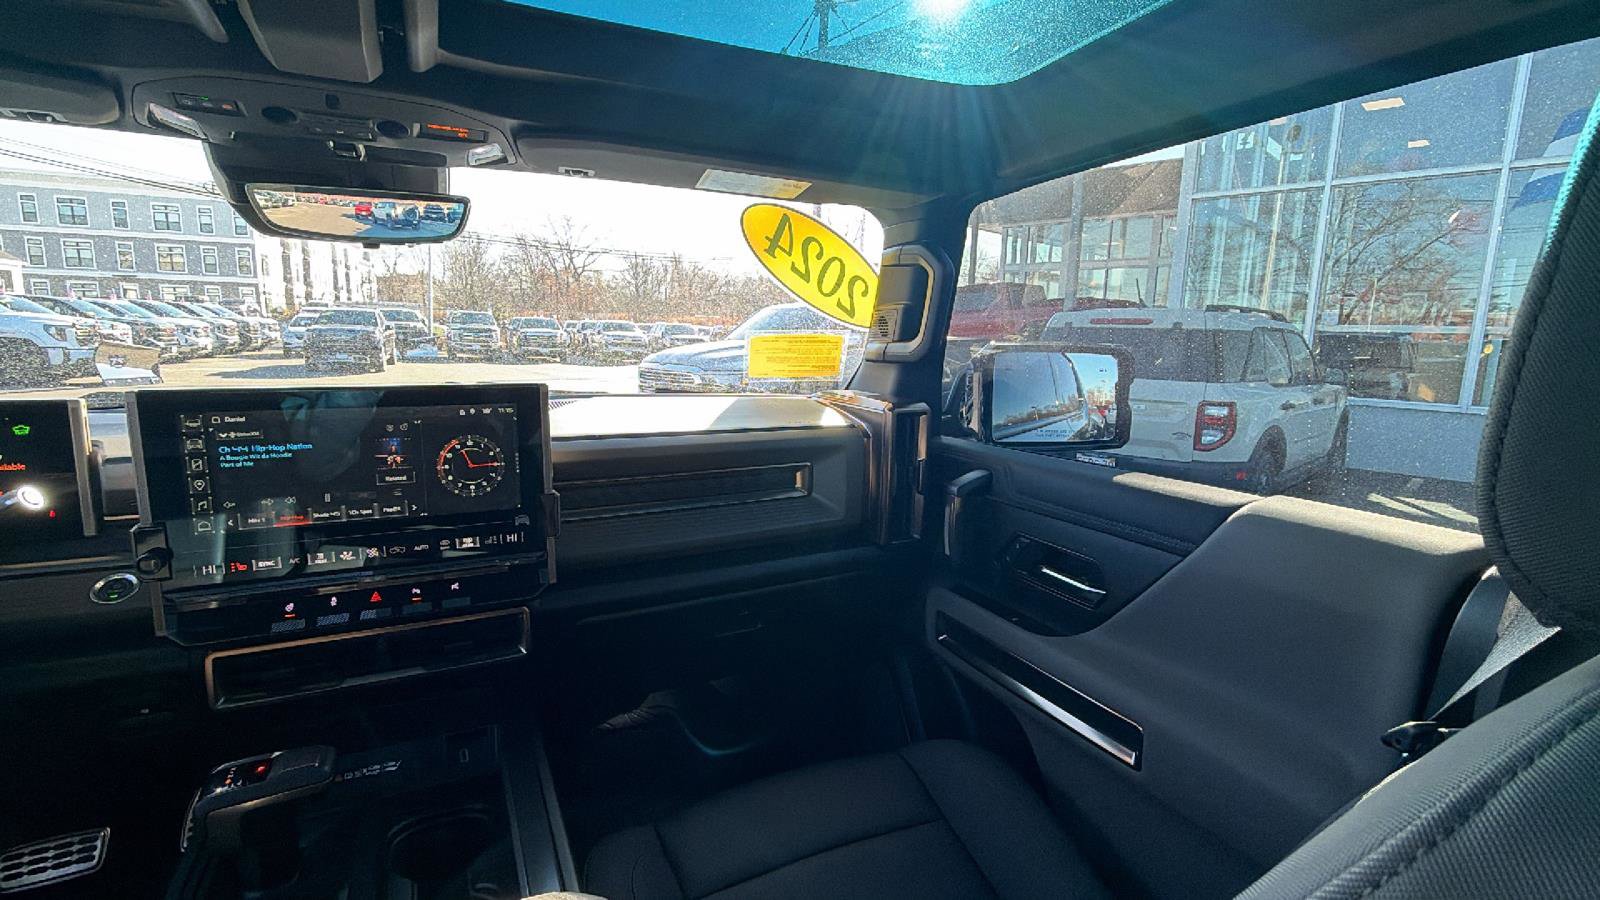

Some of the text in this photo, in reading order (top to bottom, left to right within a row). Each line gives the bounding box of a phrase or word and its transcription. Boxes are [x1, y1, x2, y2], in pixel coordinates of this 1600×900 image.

[251, 444, 286, 452] Hip-Hop
[286, 442, 313, 450] Nation
[506, 533, 518, 542] HI
[202, 565, 216, 575] HI
